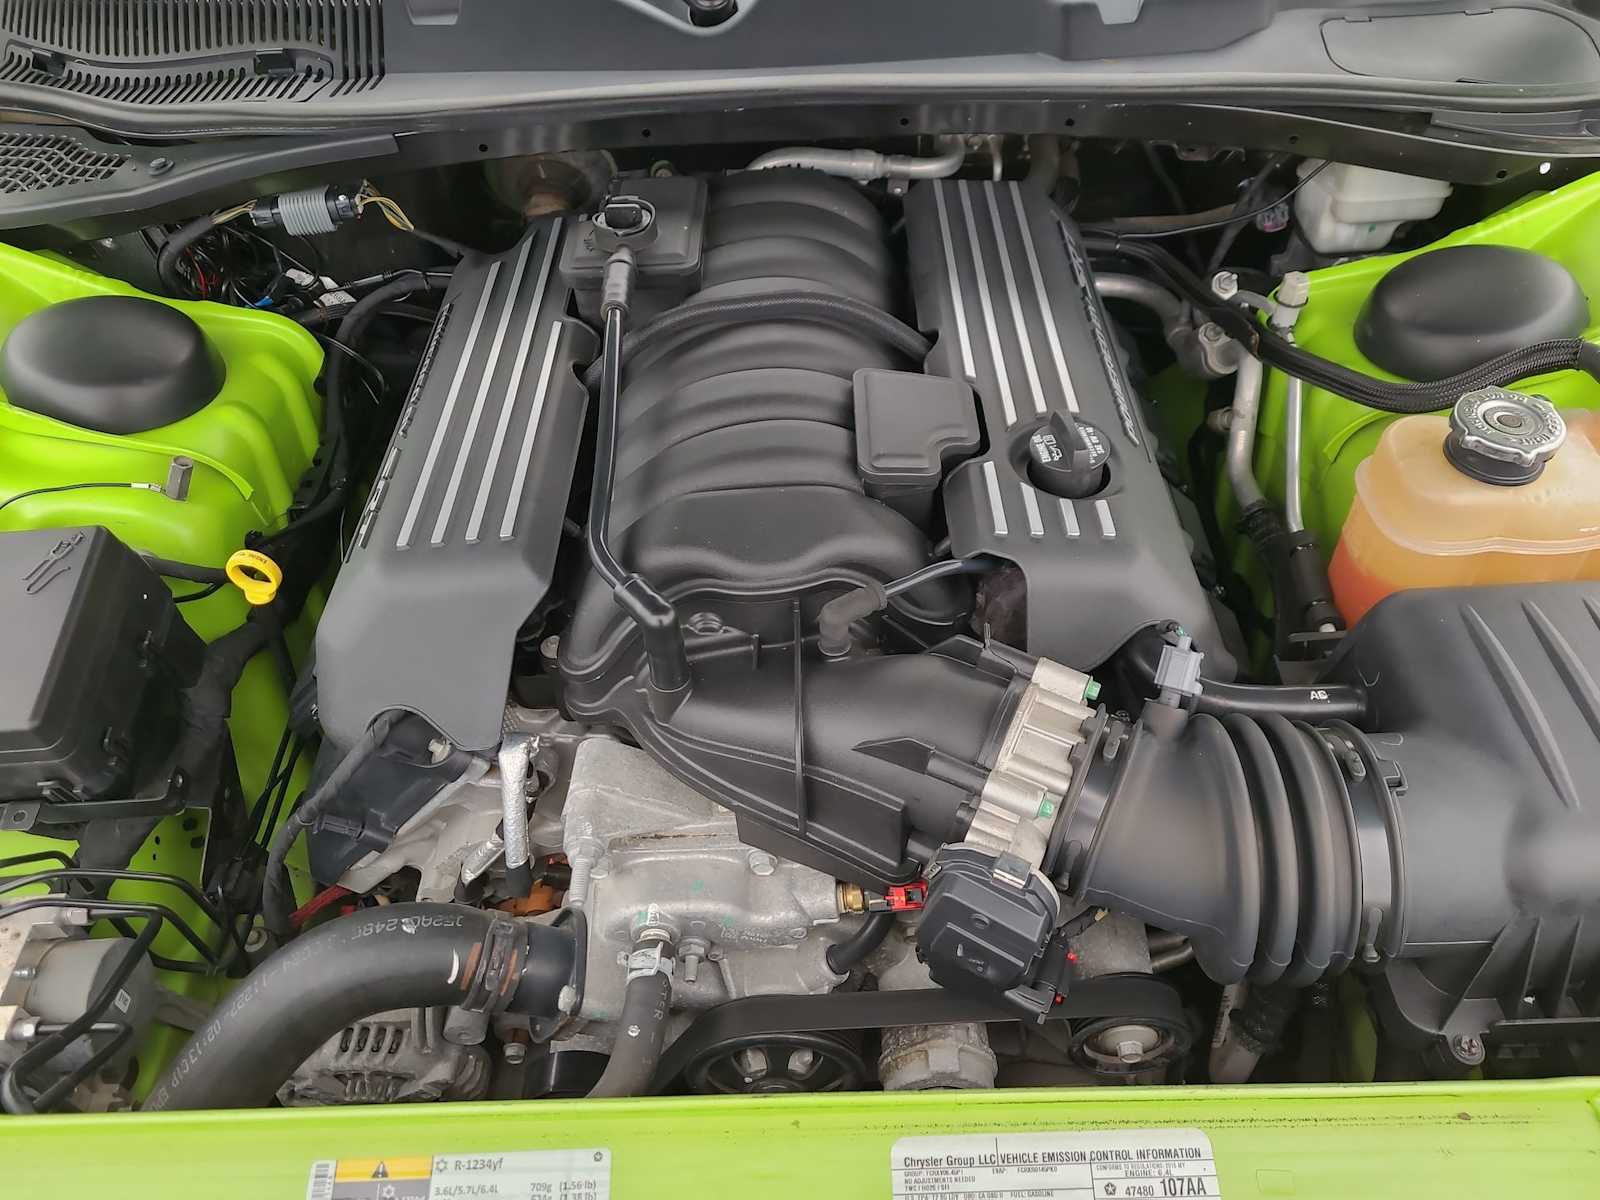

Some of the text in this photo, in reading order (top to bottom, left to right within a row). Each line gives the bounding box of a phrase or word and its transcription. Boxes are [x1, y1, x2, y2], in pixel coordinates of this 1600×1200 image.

[904, 1154, 996, 1168] Chrysler Group LLC
[1000, 1147, 1201, 1164] VEHICLE EMISSION CONTROL INFORMATION
[454, 1157, 504, 1172] R-1234yf
[1125, 1177, 1207, 1197] 47480 107AA
